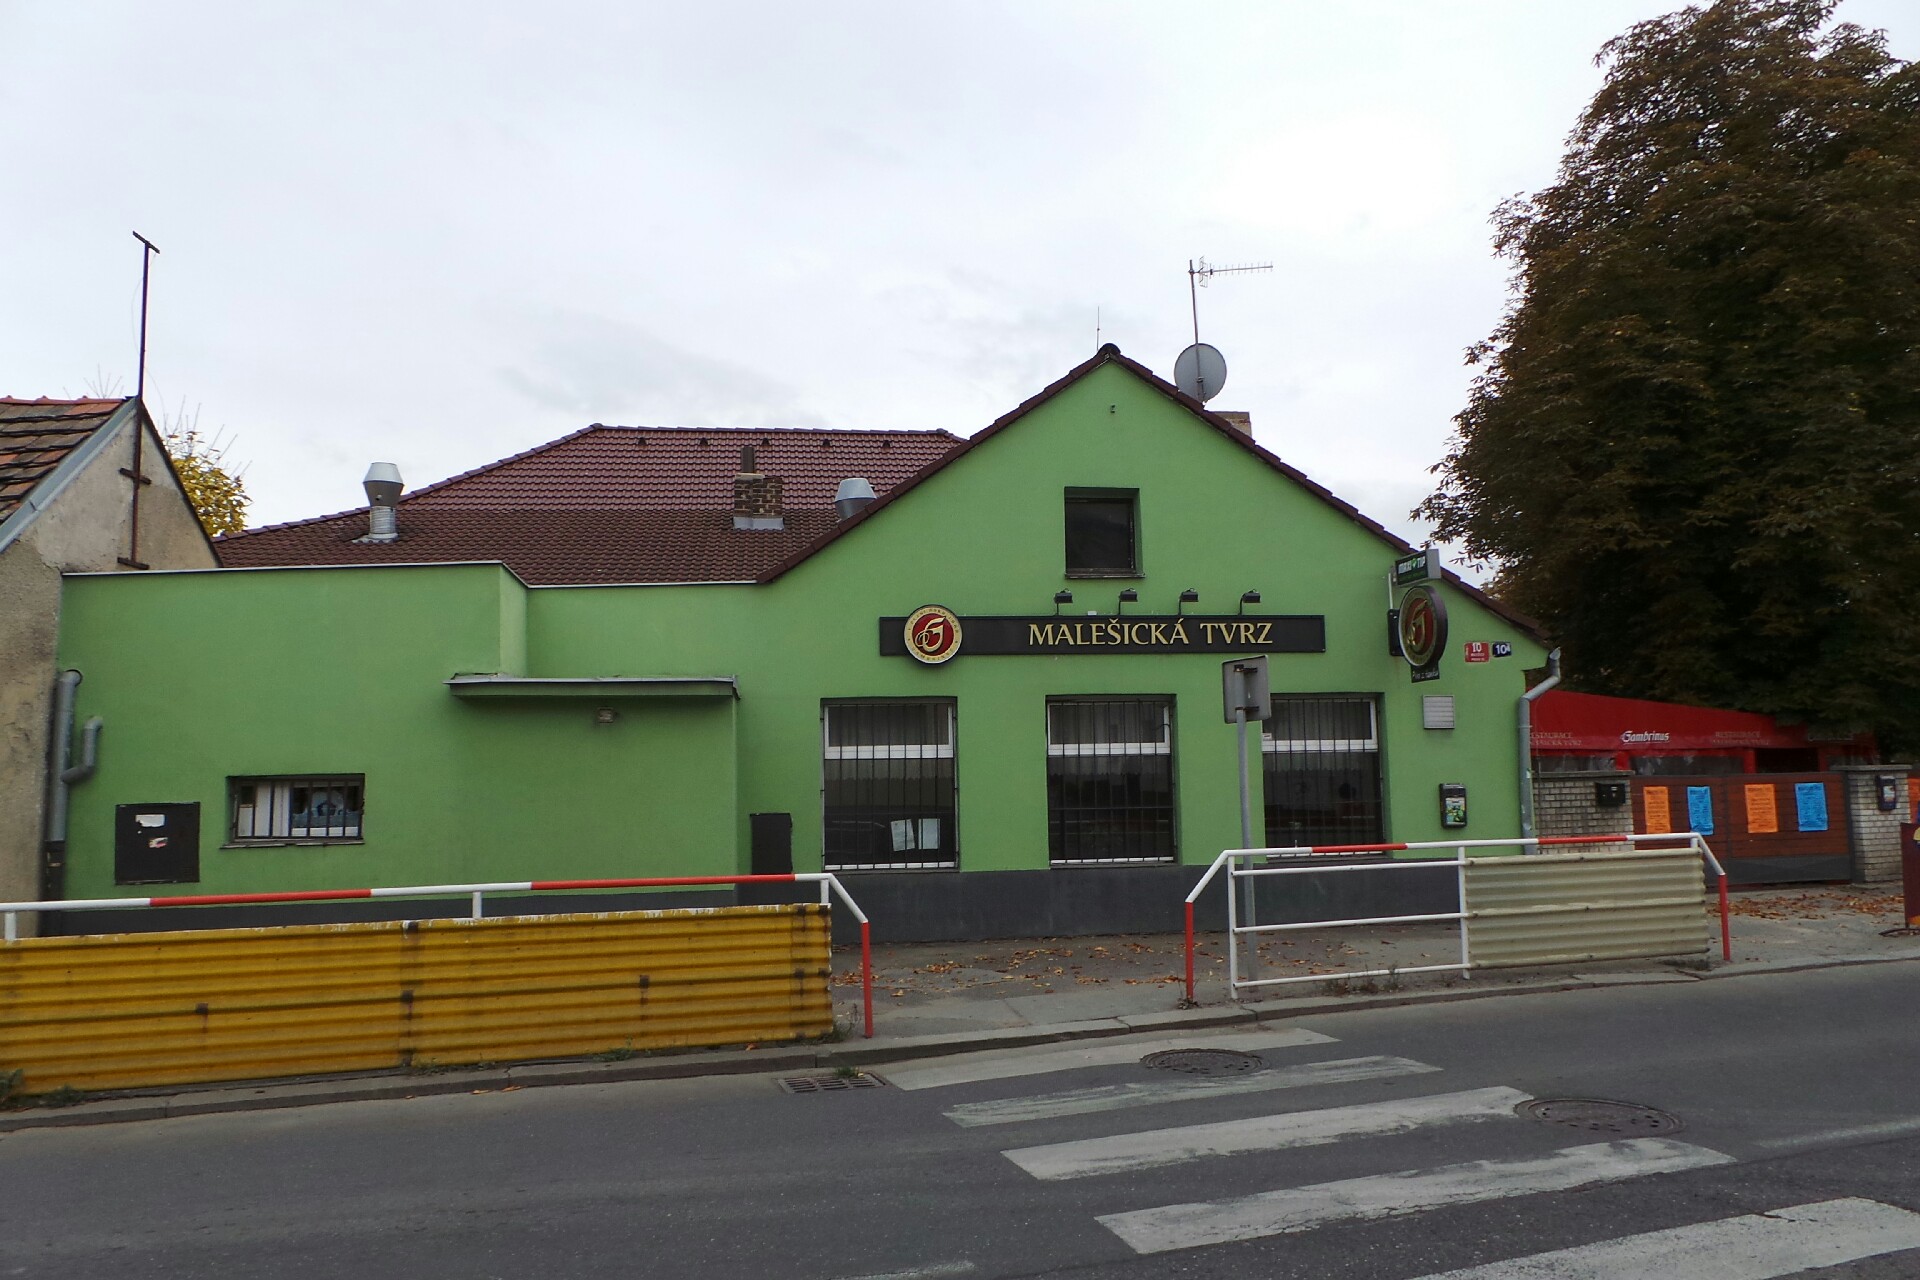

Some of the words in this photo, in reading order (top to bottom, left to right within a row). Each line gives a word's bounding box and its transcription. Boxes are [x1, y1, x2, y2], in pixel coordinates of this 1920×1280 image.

[1028, 617, 1190, 646] MALEŠICKÁ
[1199, 622, 1274, 645] TVRZ
[1472, 642, 1482, 653] 10
[1620, 730, 1671, 743] Gambrinus
